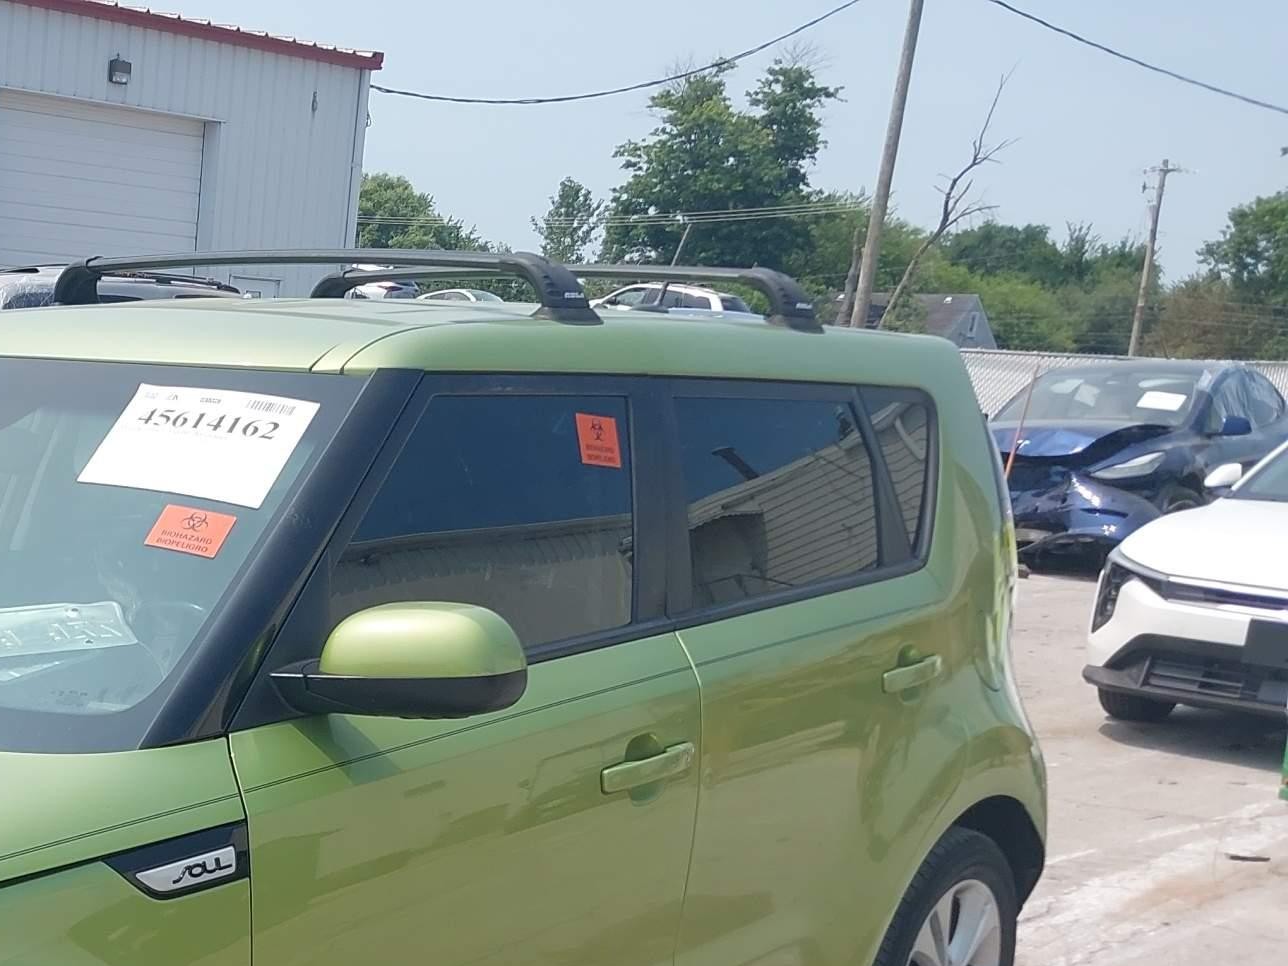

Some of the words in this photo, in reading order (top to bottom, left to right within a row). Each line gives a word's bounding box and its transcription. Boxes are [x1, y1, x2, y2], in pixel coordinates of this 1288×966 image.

[138, 408, 280, 440] 45614162
[156, 537, 209, 552] BIOPELIGRO
[161, 529, 213, 545] BIOHAZARD
